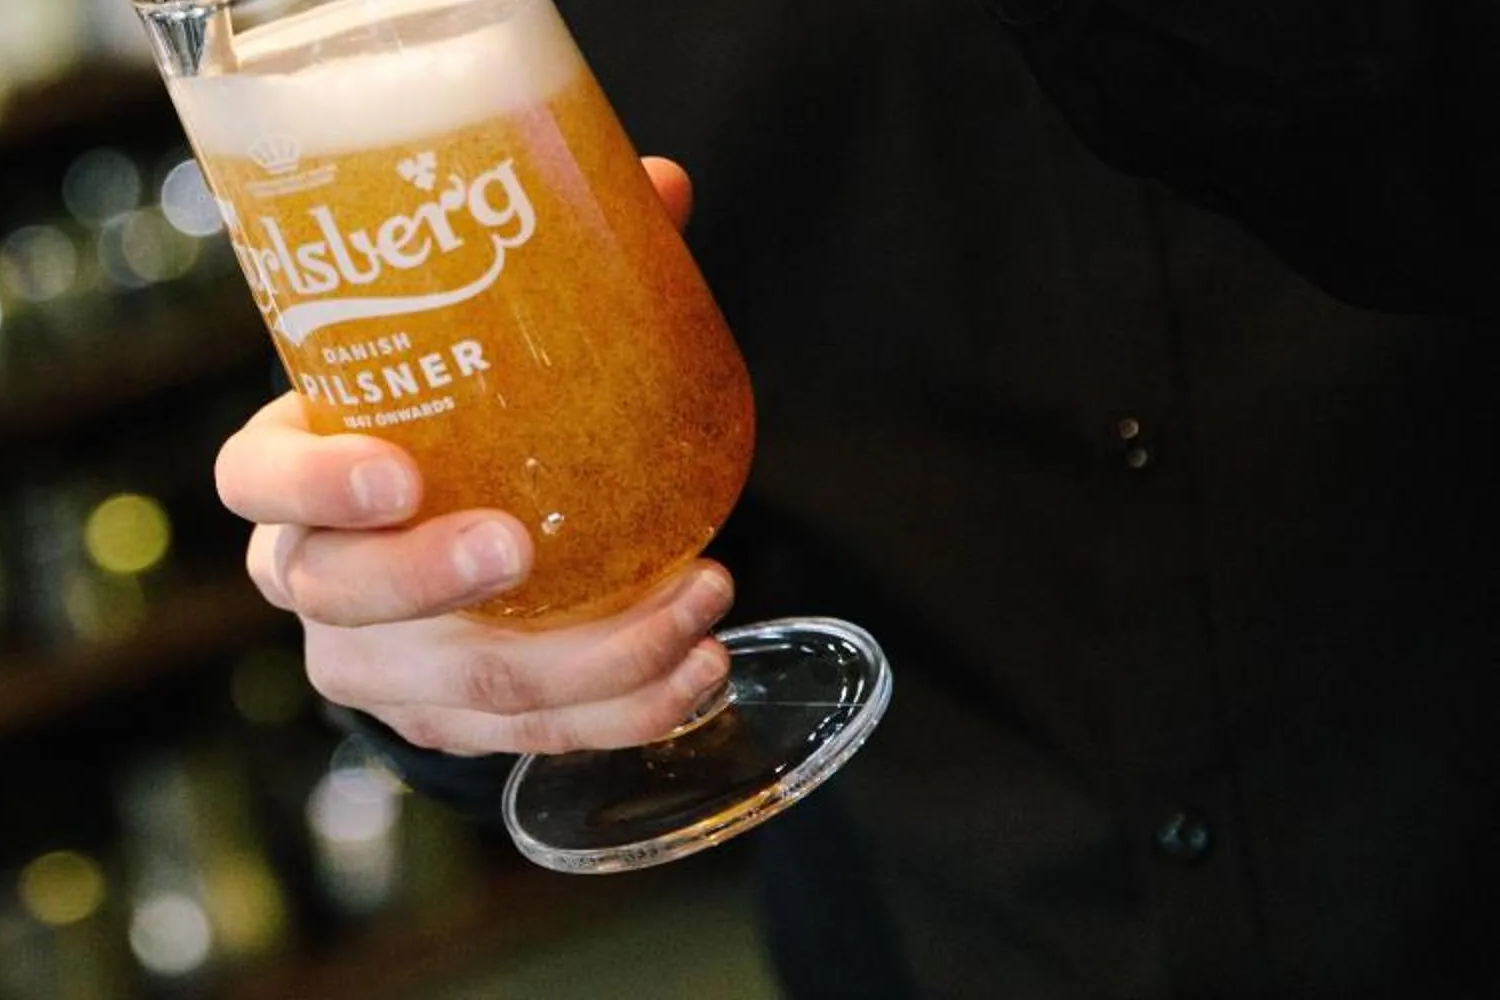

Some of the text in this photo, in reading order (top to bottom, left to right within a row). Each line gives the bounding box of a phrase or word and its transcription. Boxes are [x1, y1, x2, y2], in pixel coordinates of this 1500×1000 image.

[322, 331, 412, 365] DANISH
[300, 339, 491, 406] PILSNER
[375, 396, 456, 427] ONWARDS
